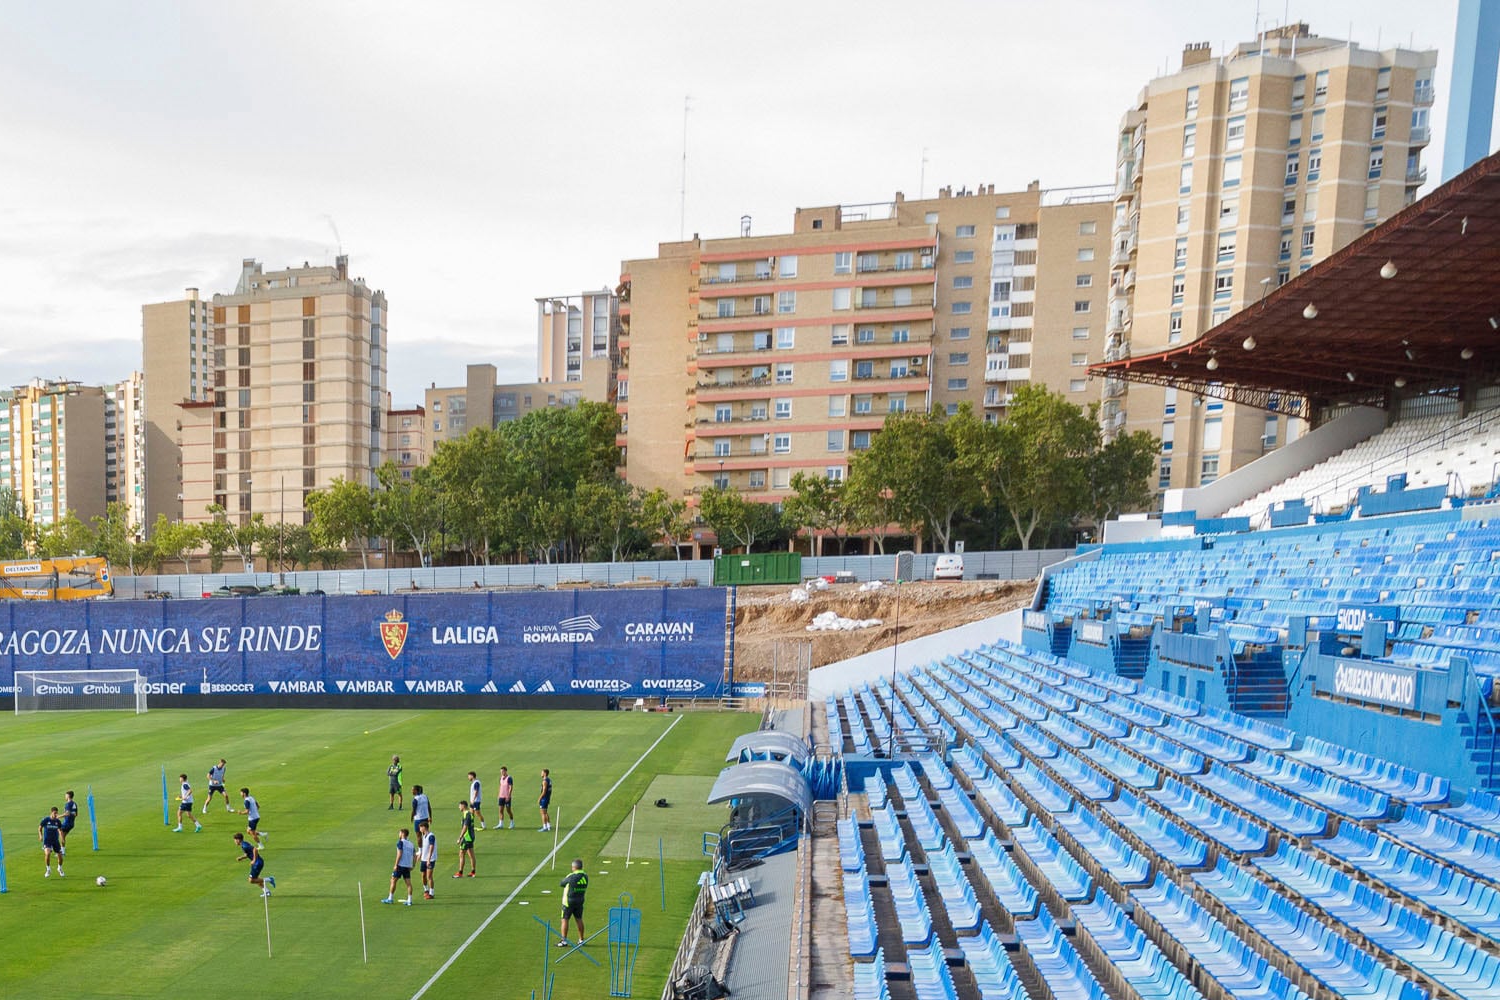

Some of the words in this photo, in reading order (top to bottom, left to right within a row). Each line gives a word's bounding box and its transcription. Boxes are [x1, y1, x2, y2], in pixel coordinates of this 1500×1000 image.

[625, 622, 694, 635] CARAVAN
[99, 628, 192, 654] NUNCA
[199, 627, 231, 653] SE
[238, 625, 321, 651] RINDE
[432, 626, 499, 645] LALIGA
[524, 632, 594, 643] ROMAREDA
[36, 684, 74, 695] embou
[82, 683, 121, 694] embou
[211, 683, 254, 692] BESOCCER
[279, 680, 326, 693] AMBAR
[348, 680, 395, 693] AMBAR
[418, 680, 465, 693] AMBAR
[570, 679, 619, 689] avanza
[642, 678, 692, 689] avanza
[1372, 671, 1413, 704] MONCAYO
